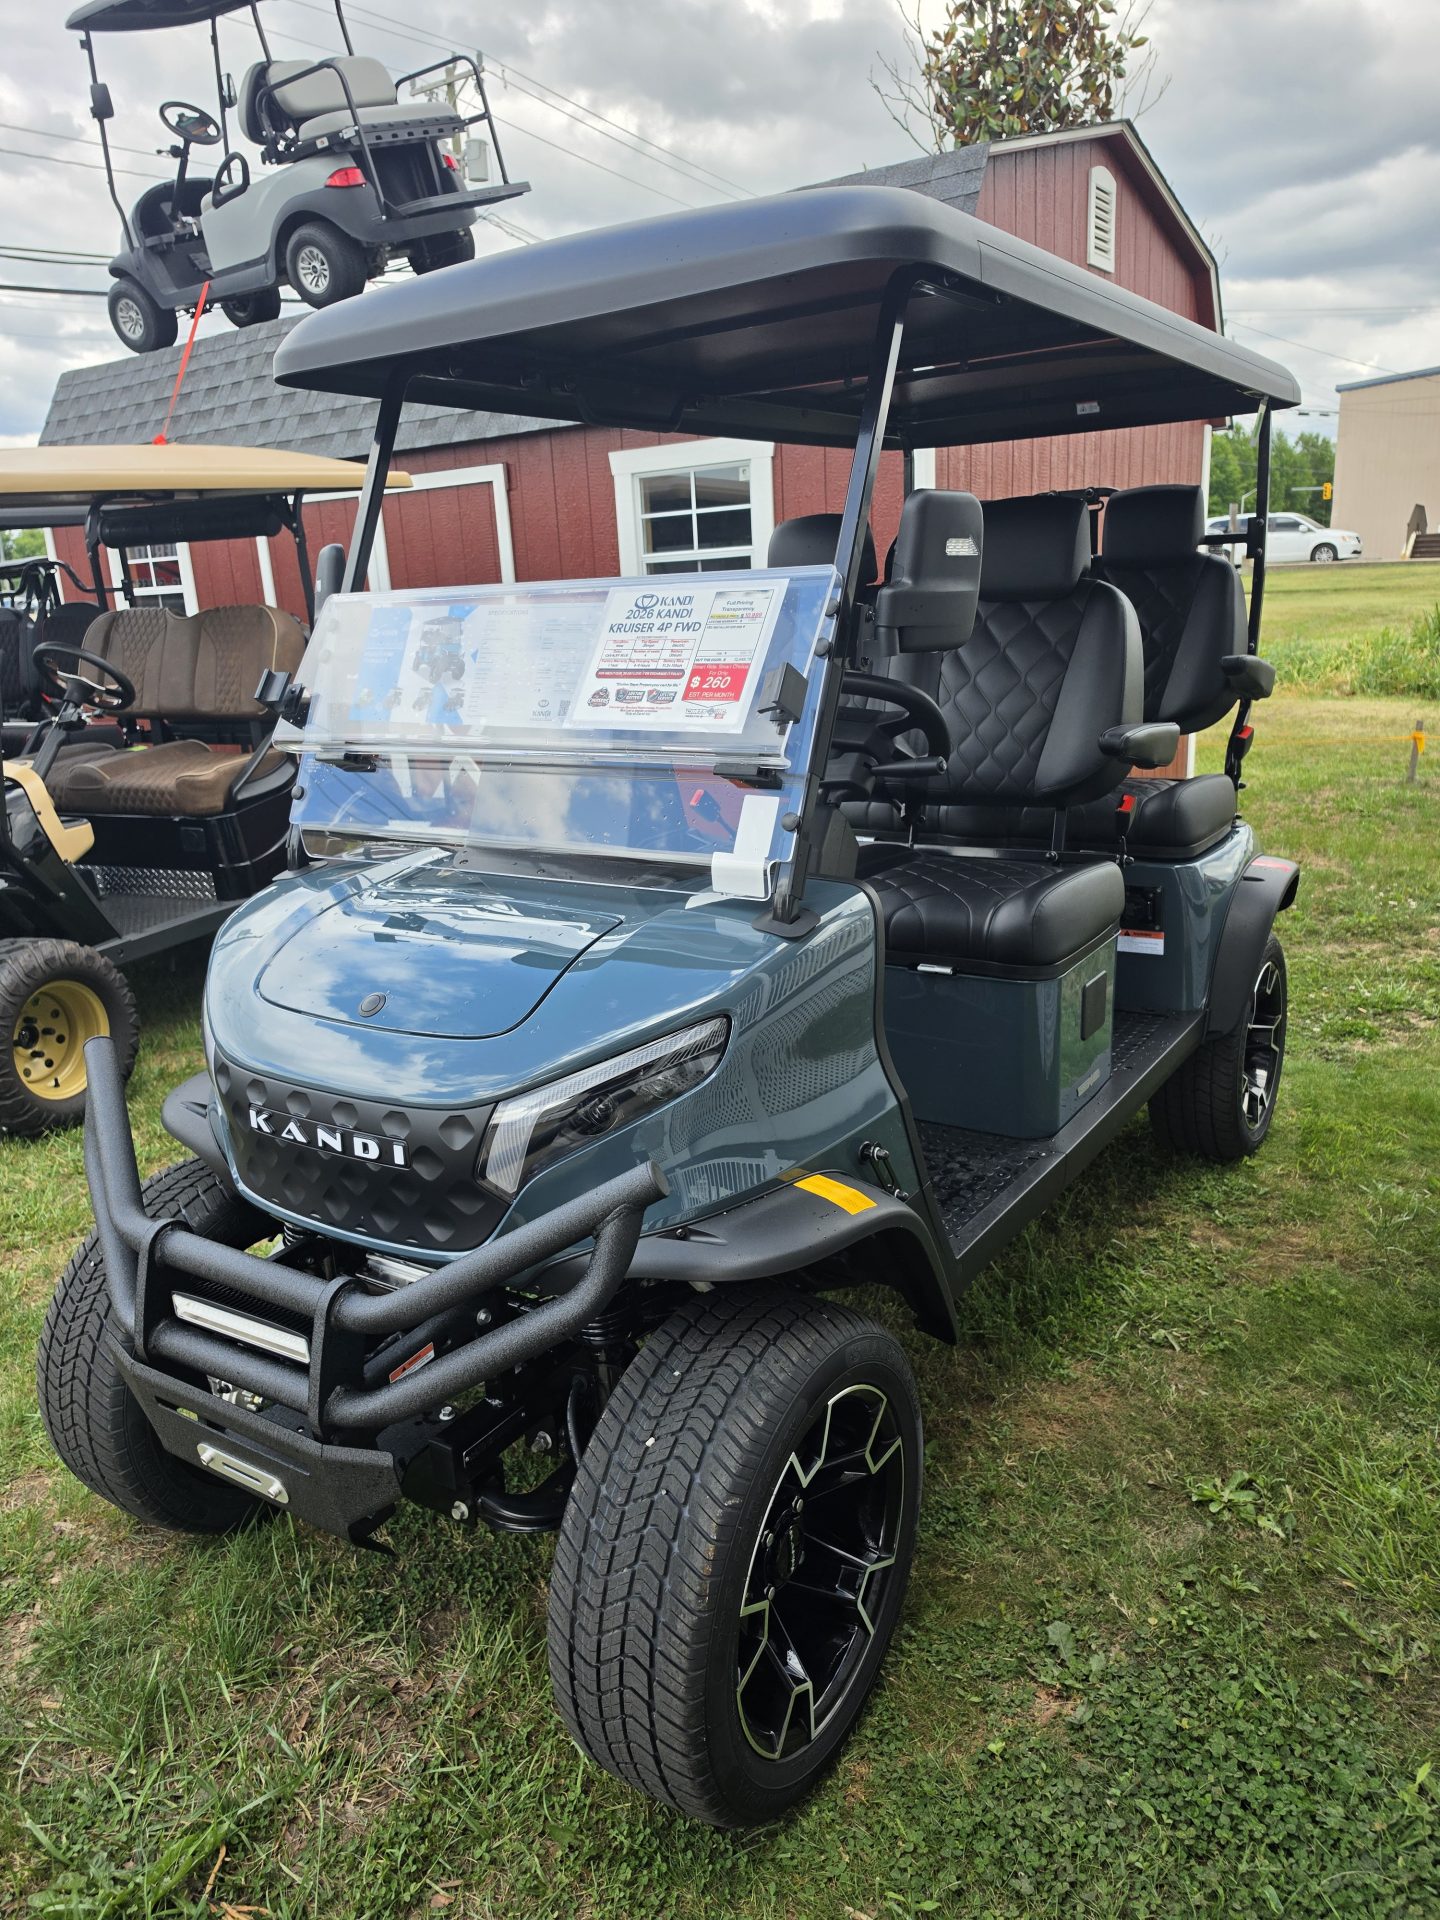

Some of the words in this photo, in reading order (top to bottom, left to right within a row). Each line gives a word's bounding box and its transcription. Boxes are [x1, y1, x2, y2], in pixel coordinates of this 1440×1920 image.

[660, 595, 695, 606] KANDI
[625, 609, 655, 620] 2026
[656, 608, 694, 619] KANDI
[608, 622, 655, 633] KRUISER
[656, 622, 673, 633] 4P
[673, 621, 702, 632] FWD
[690, 675, 701, 689] $
[702, 676, 731, 689] 260
[249, 1108, 405, 1166] KANDI
